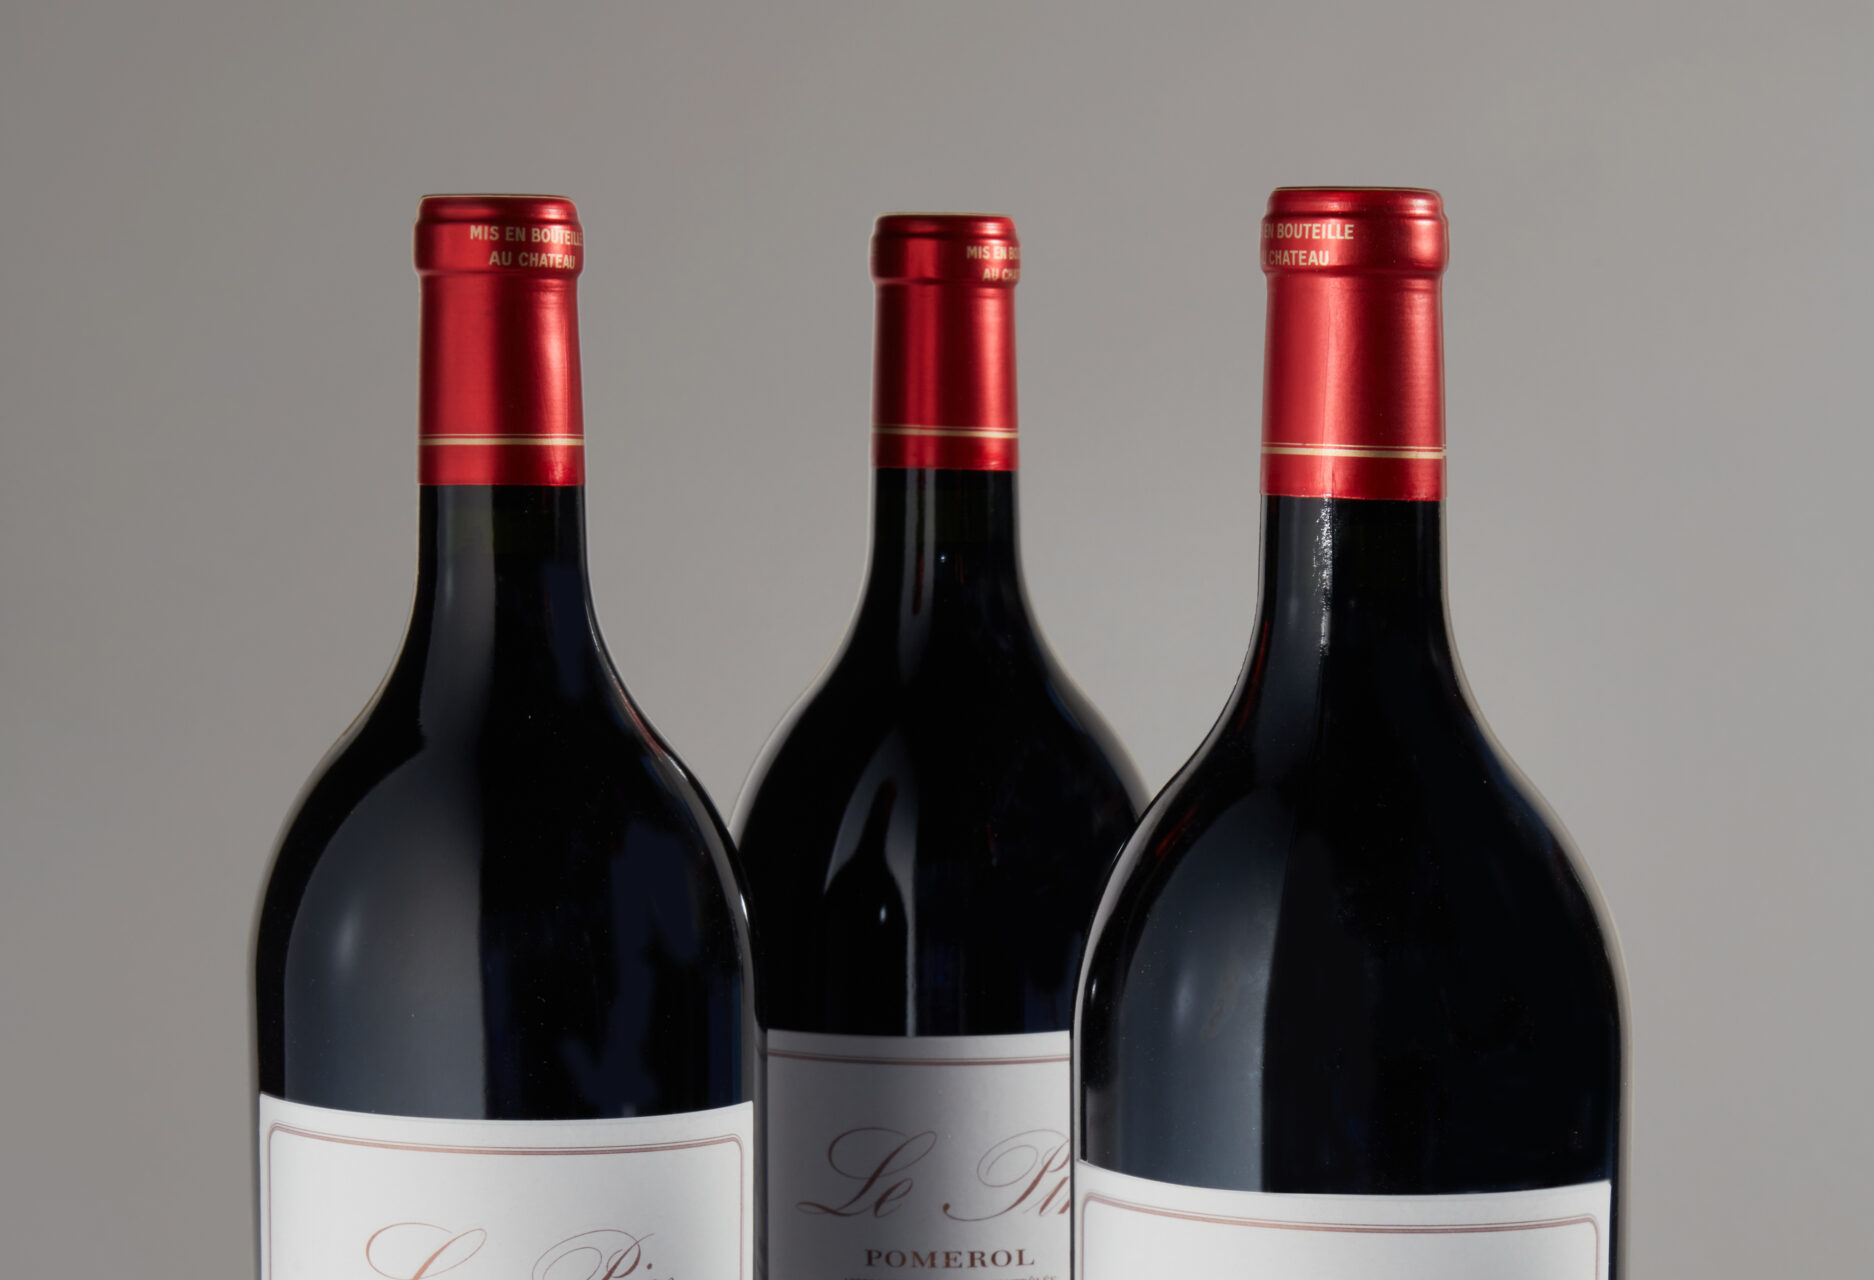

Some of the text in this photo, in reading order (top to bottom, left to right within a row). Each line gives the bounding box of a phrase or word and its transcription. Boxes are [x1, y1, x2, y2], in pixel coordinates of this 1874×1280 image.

[470, 224, 500, 241] MIS
[505, 226, 526, 242] EN
[1277, 223, 1354, 240] BOUTEILLE
[489, 250, 576, 269] AU CHATEAU
[966, 245, 990, 260] MIS
[993, 246, 1007, 260] EN
[1269, 249, 1329, 266] CHATEAU
[983, 268, 999, 281] AU
[796, 1127, 1070, 1222] Le Pi
[864, 1248, 1035, 1269] POMEROL
